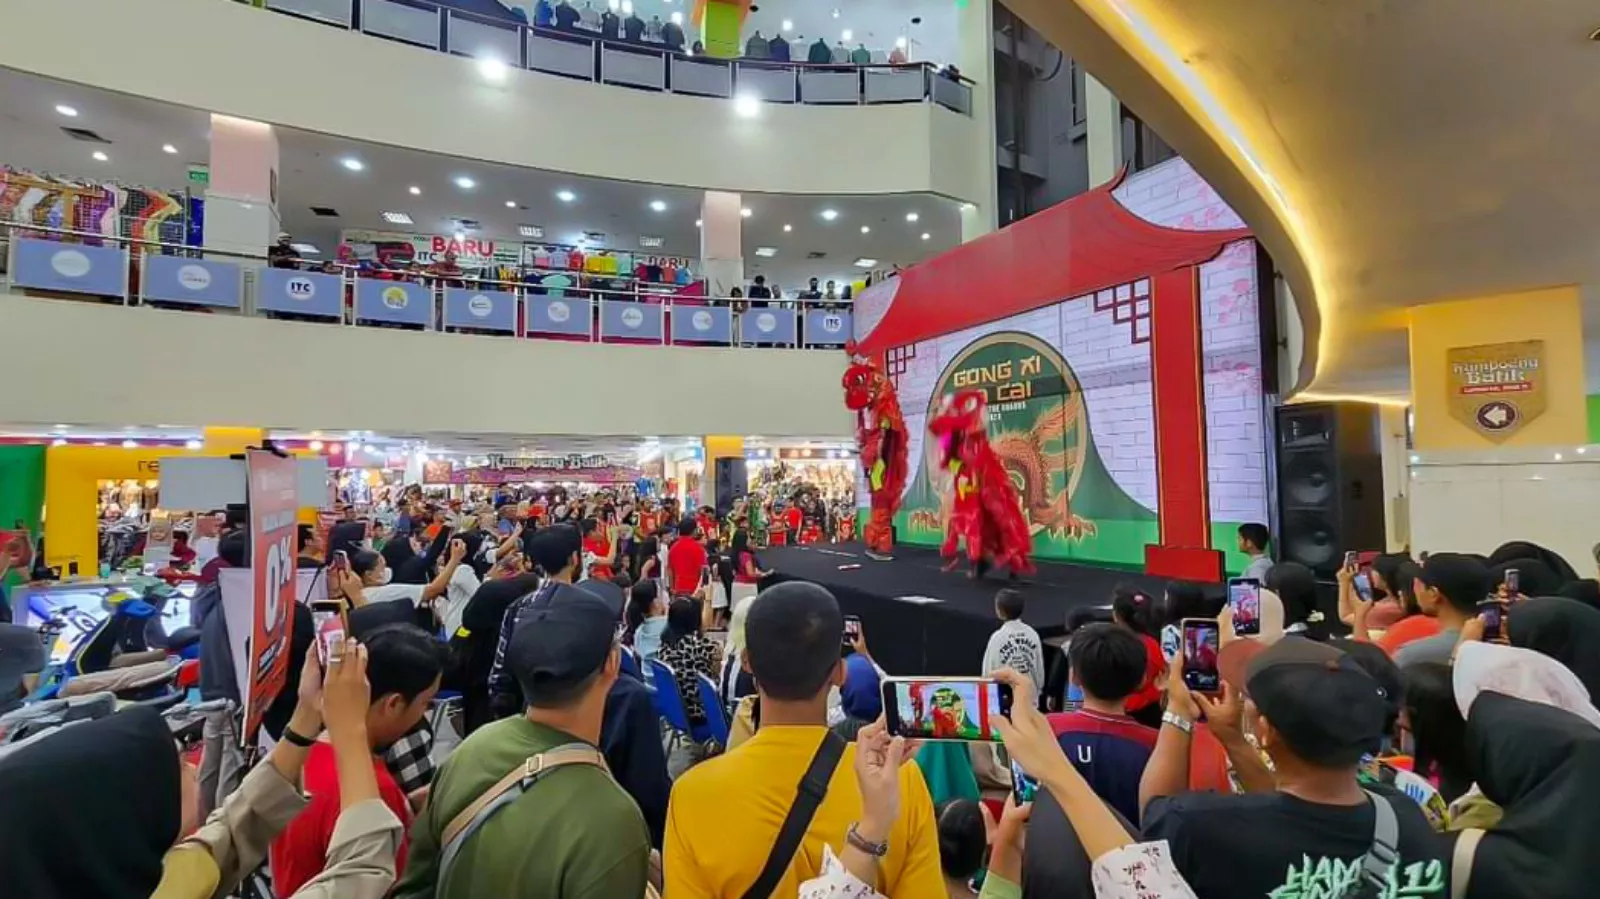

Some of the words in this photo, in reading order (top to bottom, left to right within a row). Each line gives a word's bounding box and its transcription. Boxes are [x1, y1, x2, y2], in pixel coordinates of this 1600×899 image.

[432, 235, 495, 257] BARU
[417, 251, 438, 262] ITC
[290, 281, 311, 293] ITC
[954, 360, 1013, 387] GONG
[1020, 355, 1041, 377] XI
[1466, 368, 1526, 384] Batik
[1077, 744, 1092, 763] U
